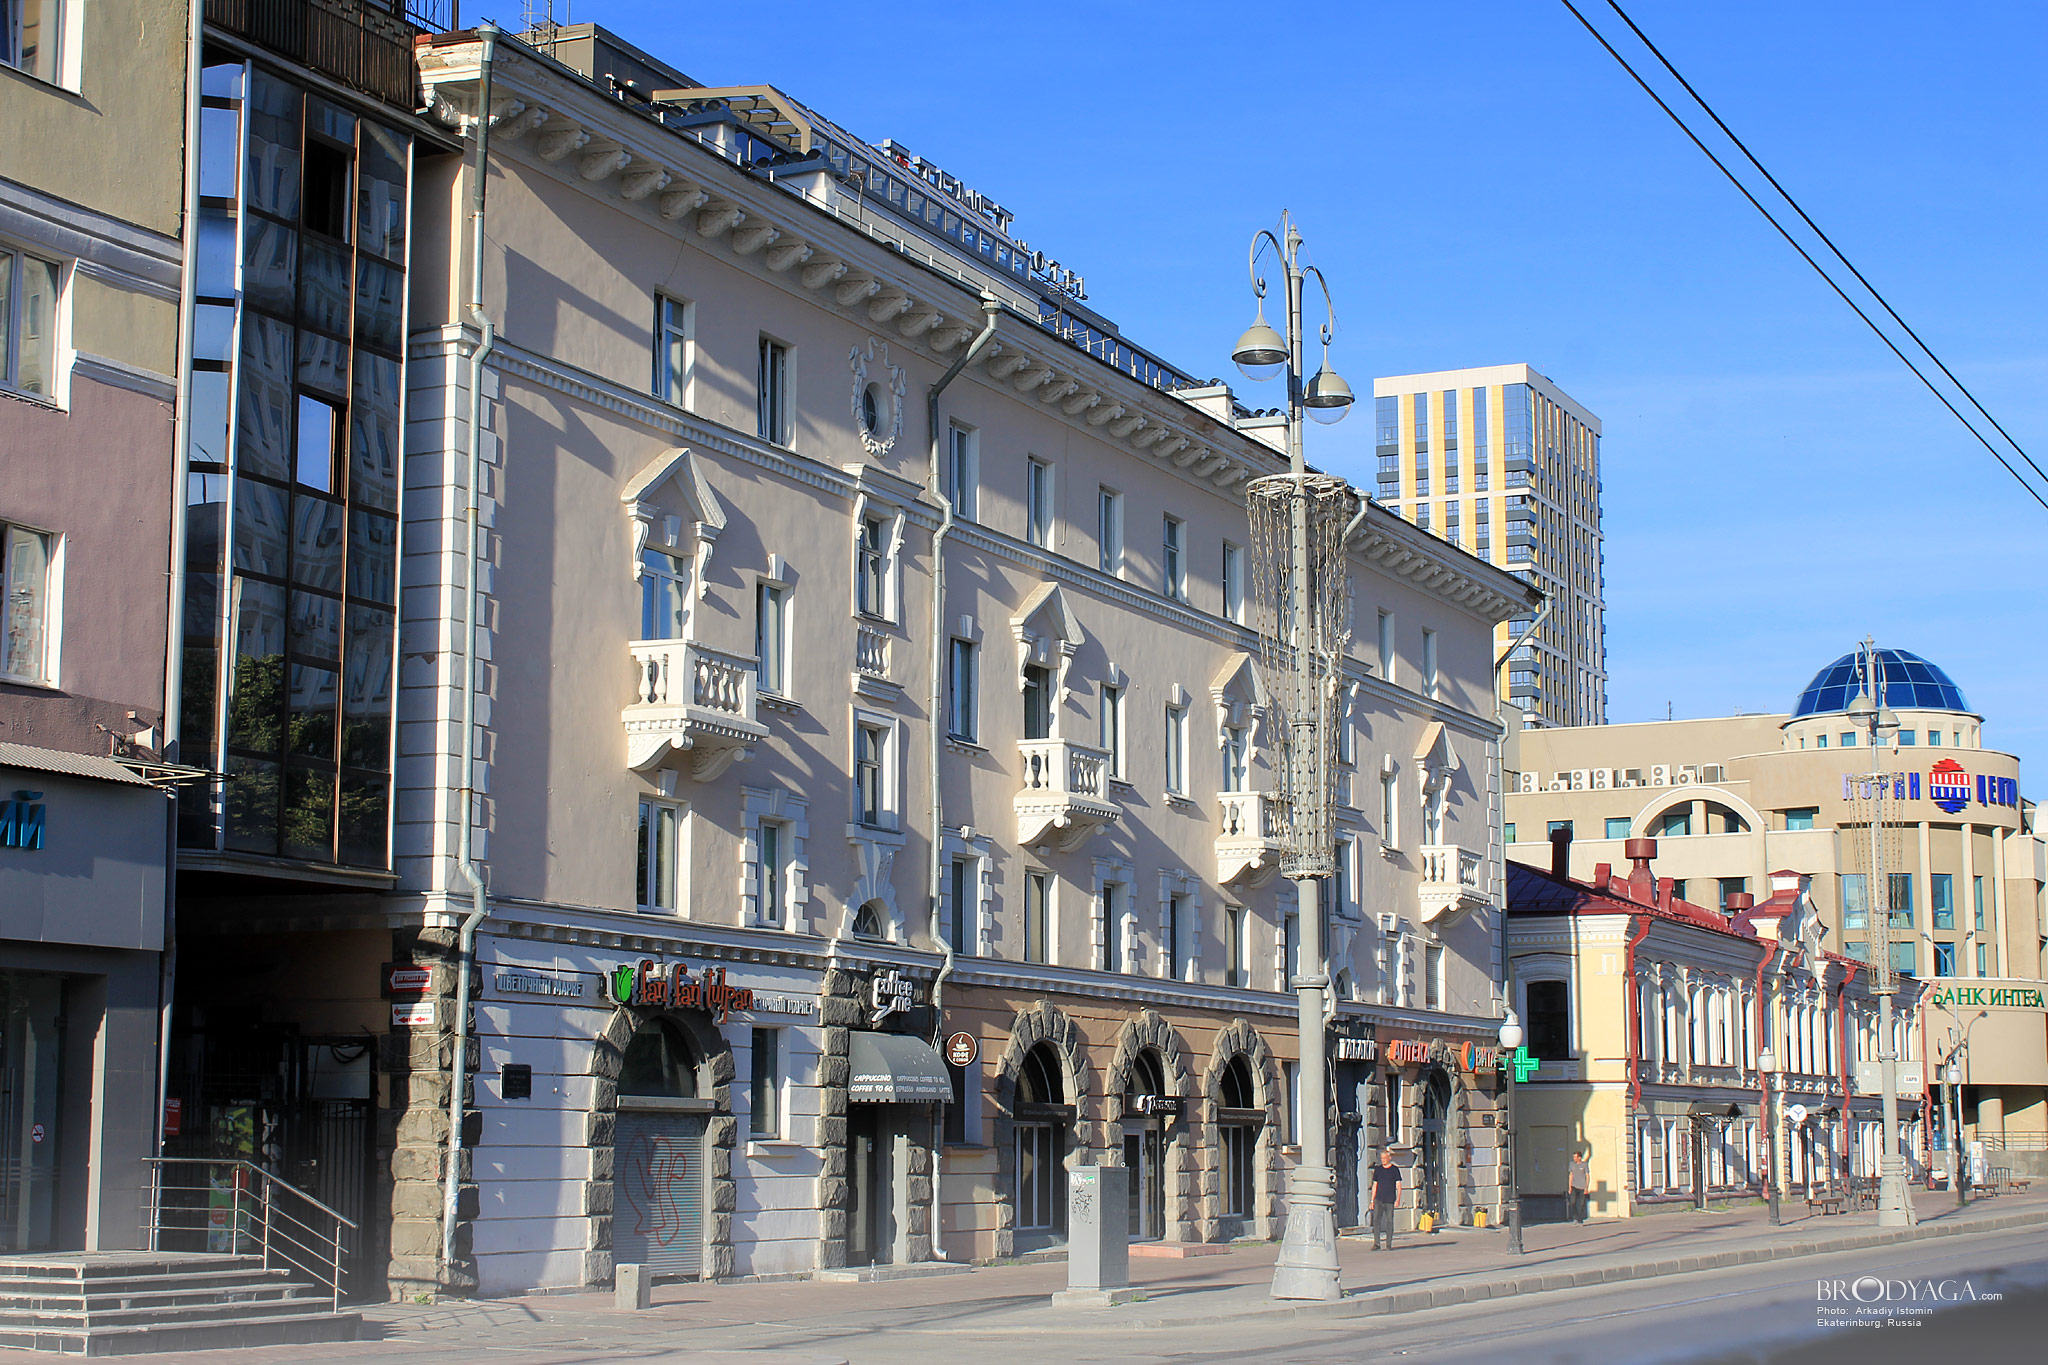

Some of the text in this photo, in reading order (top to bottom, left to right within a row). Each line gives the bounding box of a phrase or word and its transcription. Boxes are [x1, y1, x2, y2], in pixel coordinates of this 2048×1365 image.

[497, 974, 552, 995] ЦВЕТОЧНЫЙ
[640, 959, 753, 1025] fan fan tulpan
[878, 970, 913, 996] coffee
[1931, 986, 2045, 1008] БАНК ИНТЕЗА
[1389, 1040, 1431, 1063] АПТЕКА
[850, 1085, 894, 1093] COFFEE TO GO
[853, 1074, 892, 1083] CAPPUCCINO
